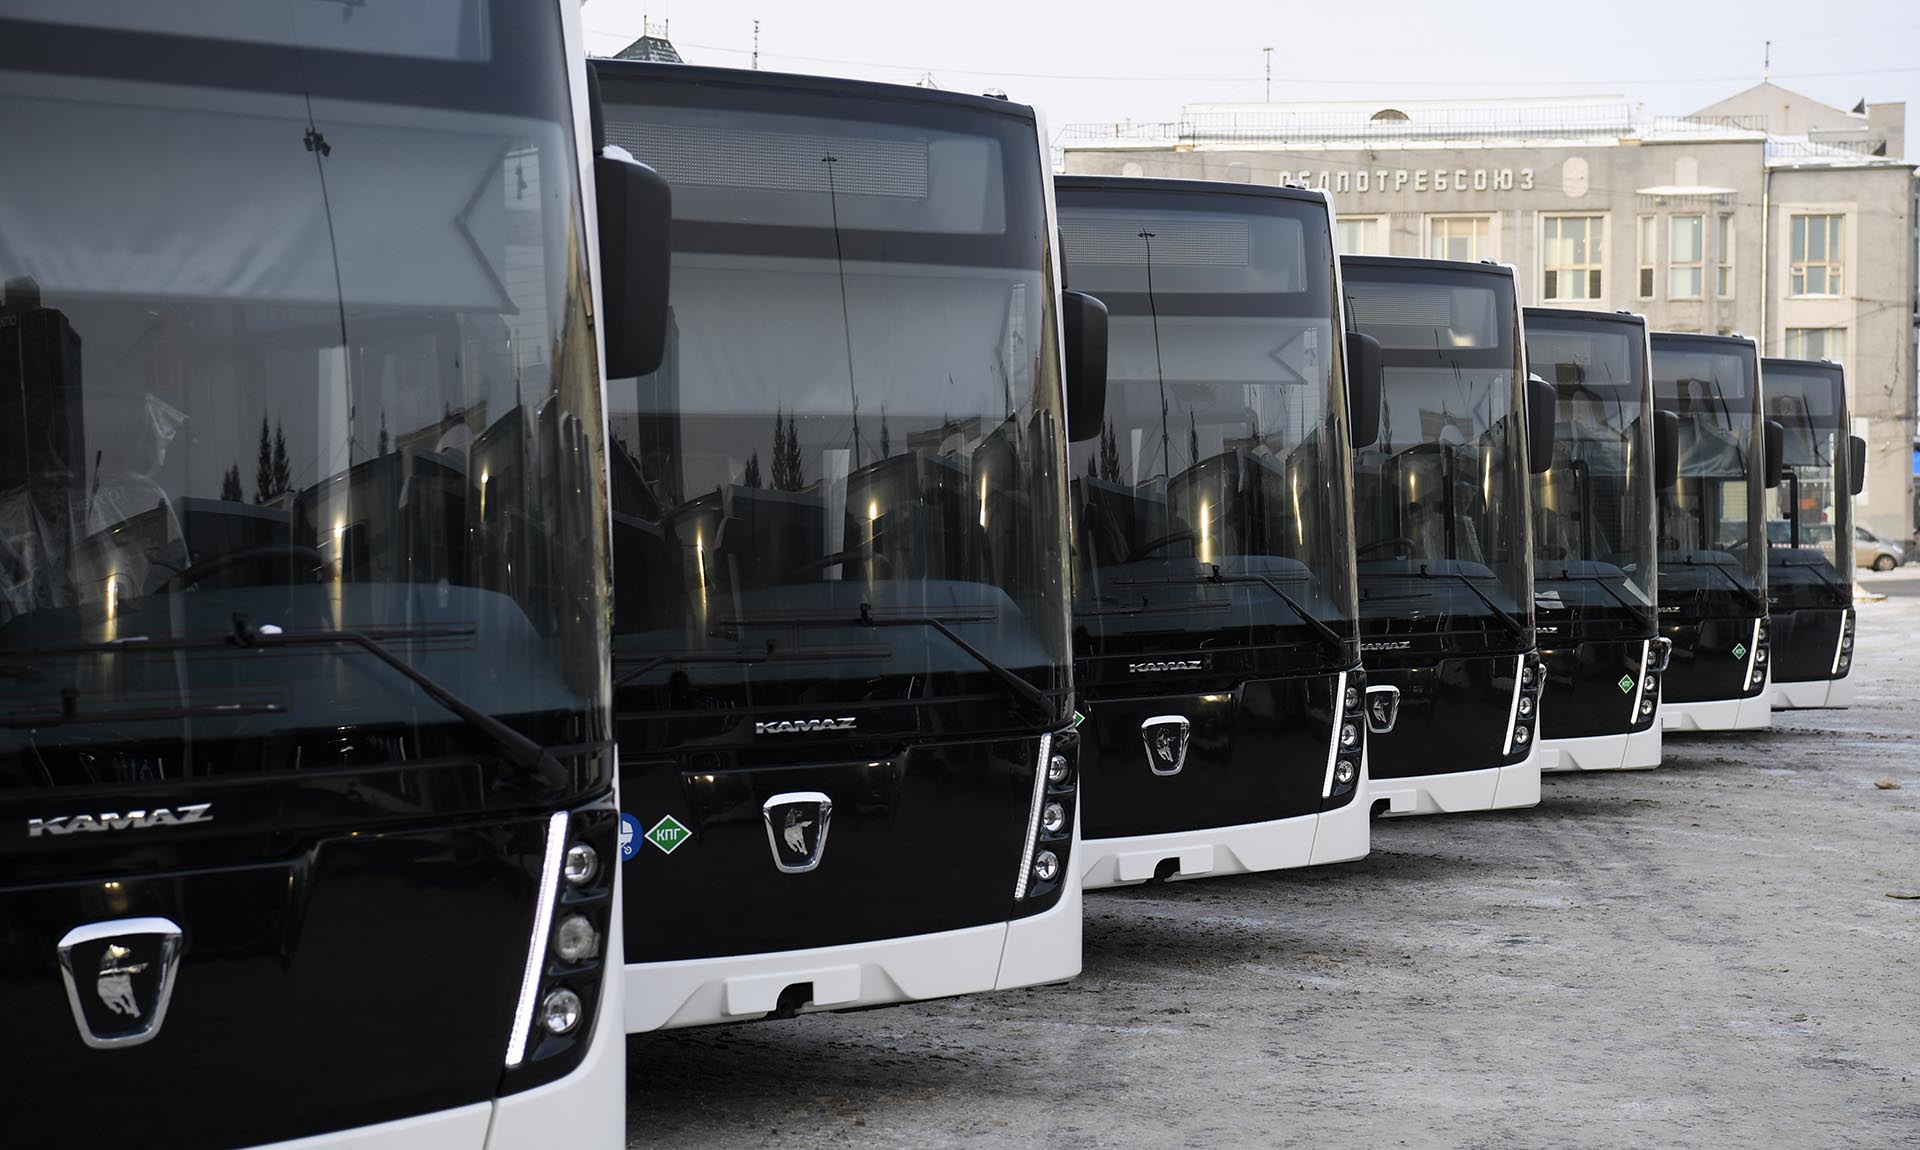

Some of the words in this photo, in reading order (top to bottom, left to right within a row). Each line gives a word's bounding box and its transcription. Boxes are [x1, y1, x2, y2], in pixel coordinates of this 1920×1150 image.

[1129, 660, 1202, 673] KAMAZ
[756, 717, 857, 734] KAMAZ
[28, 803, 214, 837] KAMAZ
[656, 828, 681, 841] КПГ
